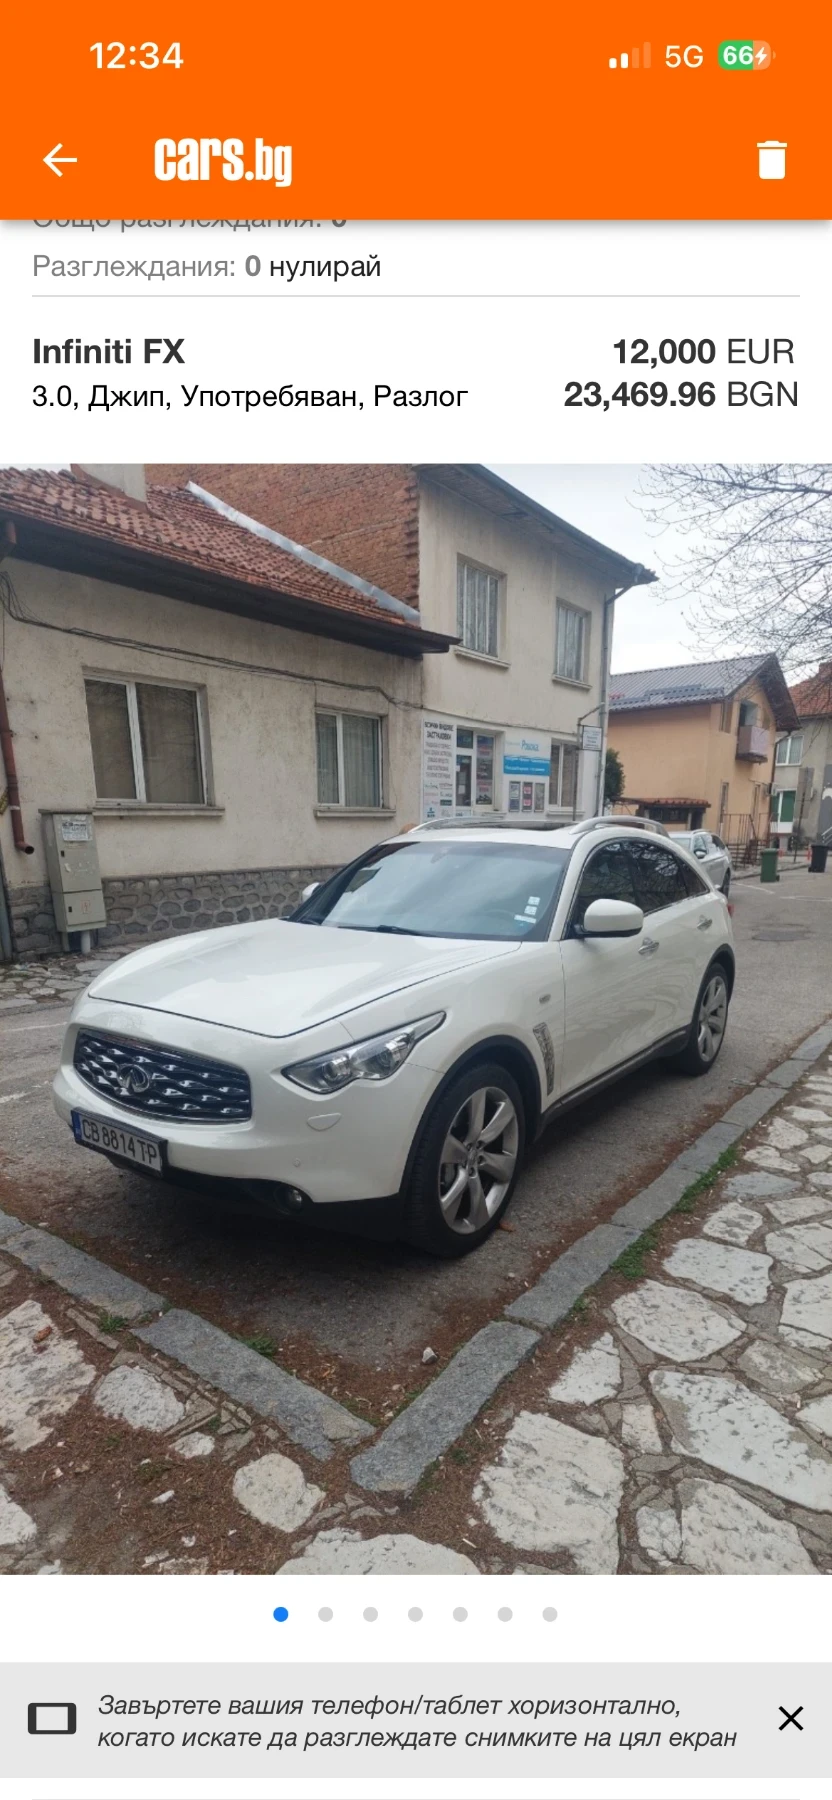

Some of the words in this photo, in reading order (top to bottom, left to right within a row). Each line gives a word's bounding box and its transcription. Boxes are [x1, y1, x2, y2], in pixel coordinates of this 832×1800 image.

[90, 42, 184, 69] 12:34
[665, 45, 704, 69] 5G
[723, 45, 754, 66] 66
[154, 138, 292, 187] cars.bg
[33, 255, 235, 282] Разглеждания:
[245, 255, 261, 278] 0
[269, 254, 381, 283] нулирай
[33, 338, 131, 364] Infiniti
[143, 338, 186, 364] FX
[613, 338, 717, 369] 12,000
[727, 338, 795, 365] EUR
[32, 385, 79, 411] 3.0,
[87, 385, 171, 412] Джип,
[180, 384, 364, 413] Употребяван,
[374, 385, 469, 408] Разлог
[564, 381, 717, 412] 23,469.96
[727, 381, 799, 408] BGN
[82, 1119, 100, 1143] CB
[101, 1126, 136, 1158] 8814
[137, 1140, 157, 1164] TP
[98, 1693, 222, 1720] Завъртете
[228, 1700, 304, 1716] вашия
[311, 1693, 502, 1720] телефон/таблет
[508, 1693, 681, 1720] хоризонтално,
[98, 1732, 175, 1748] когато
[182, 1732, 262, 1748] искате
[268, 1732, 297, 1751] да
[303, 1732, 458, 1752] разглеждате
[464, 1732, 578, 1748] снимките
[584, 1732, 612, 1748] на
[618, 1732, 662, 1751] цял
[668, 1732, 738, 1752] екран
